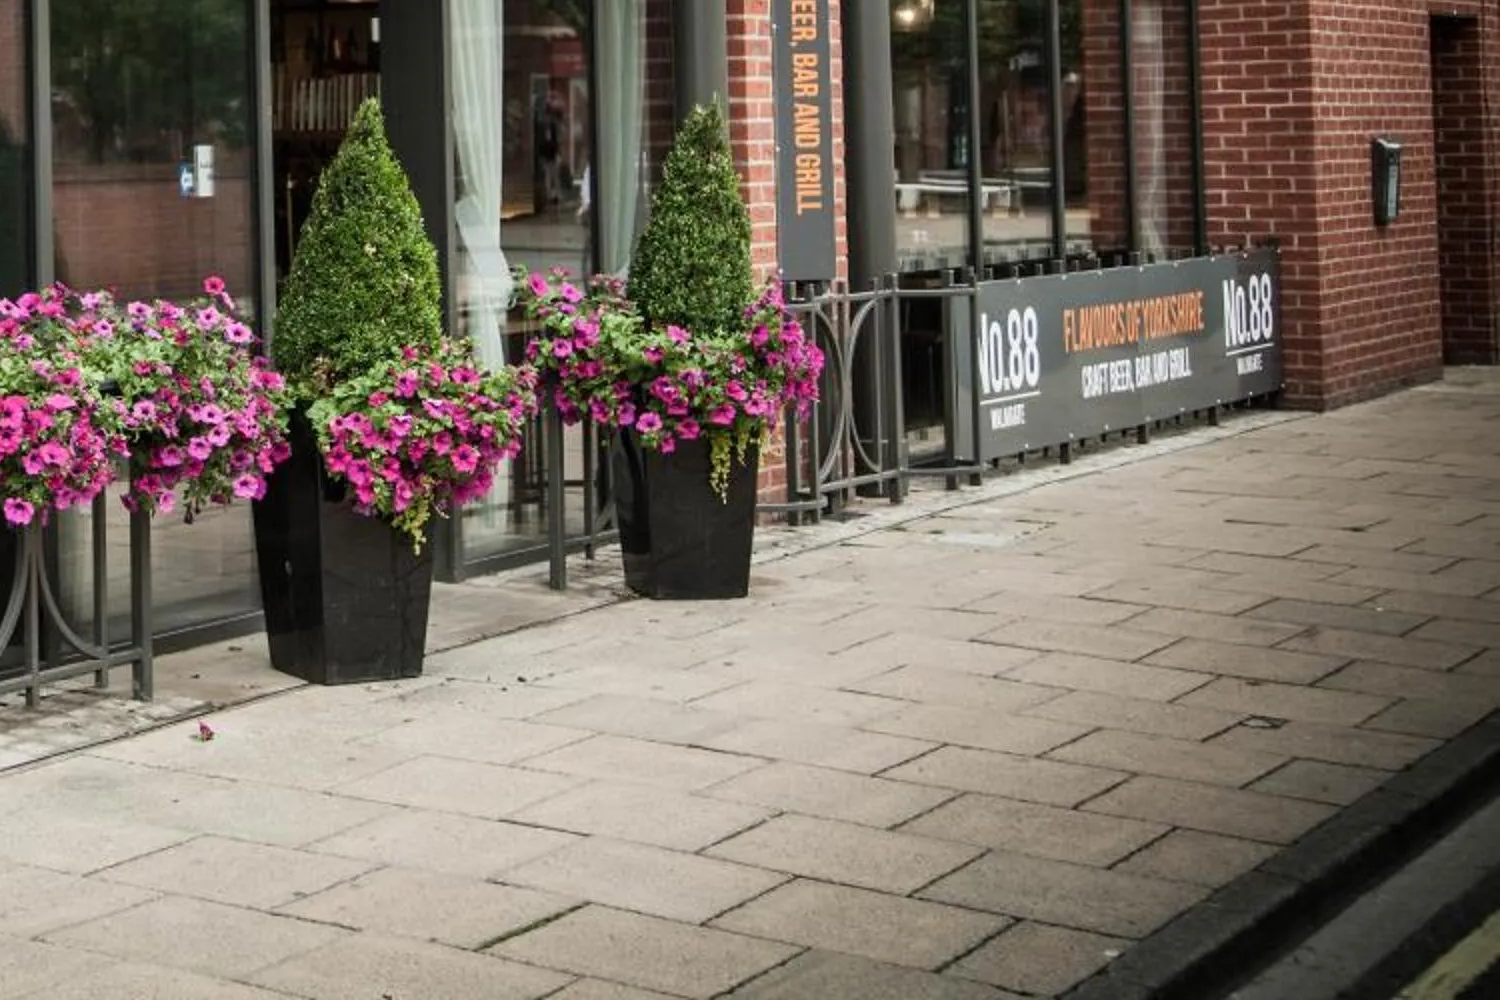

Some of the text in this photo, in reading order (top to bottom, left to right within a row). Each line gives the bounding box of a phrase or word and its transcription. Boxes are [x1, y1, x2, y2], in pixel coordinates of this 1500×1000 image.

[793, 53, 818, 97] BAR
[794, 103, 821, 148] AND
[795, 153, 823, 216] GRILL
[1063, 291, 1204, 354] FLAVOURS OF YORKSHIRE
[1082, 363, 1109, 398] CRAFT
[1135, 355, 1153, 388] BAR
[1169, 346, 1193, 380] GRILL
